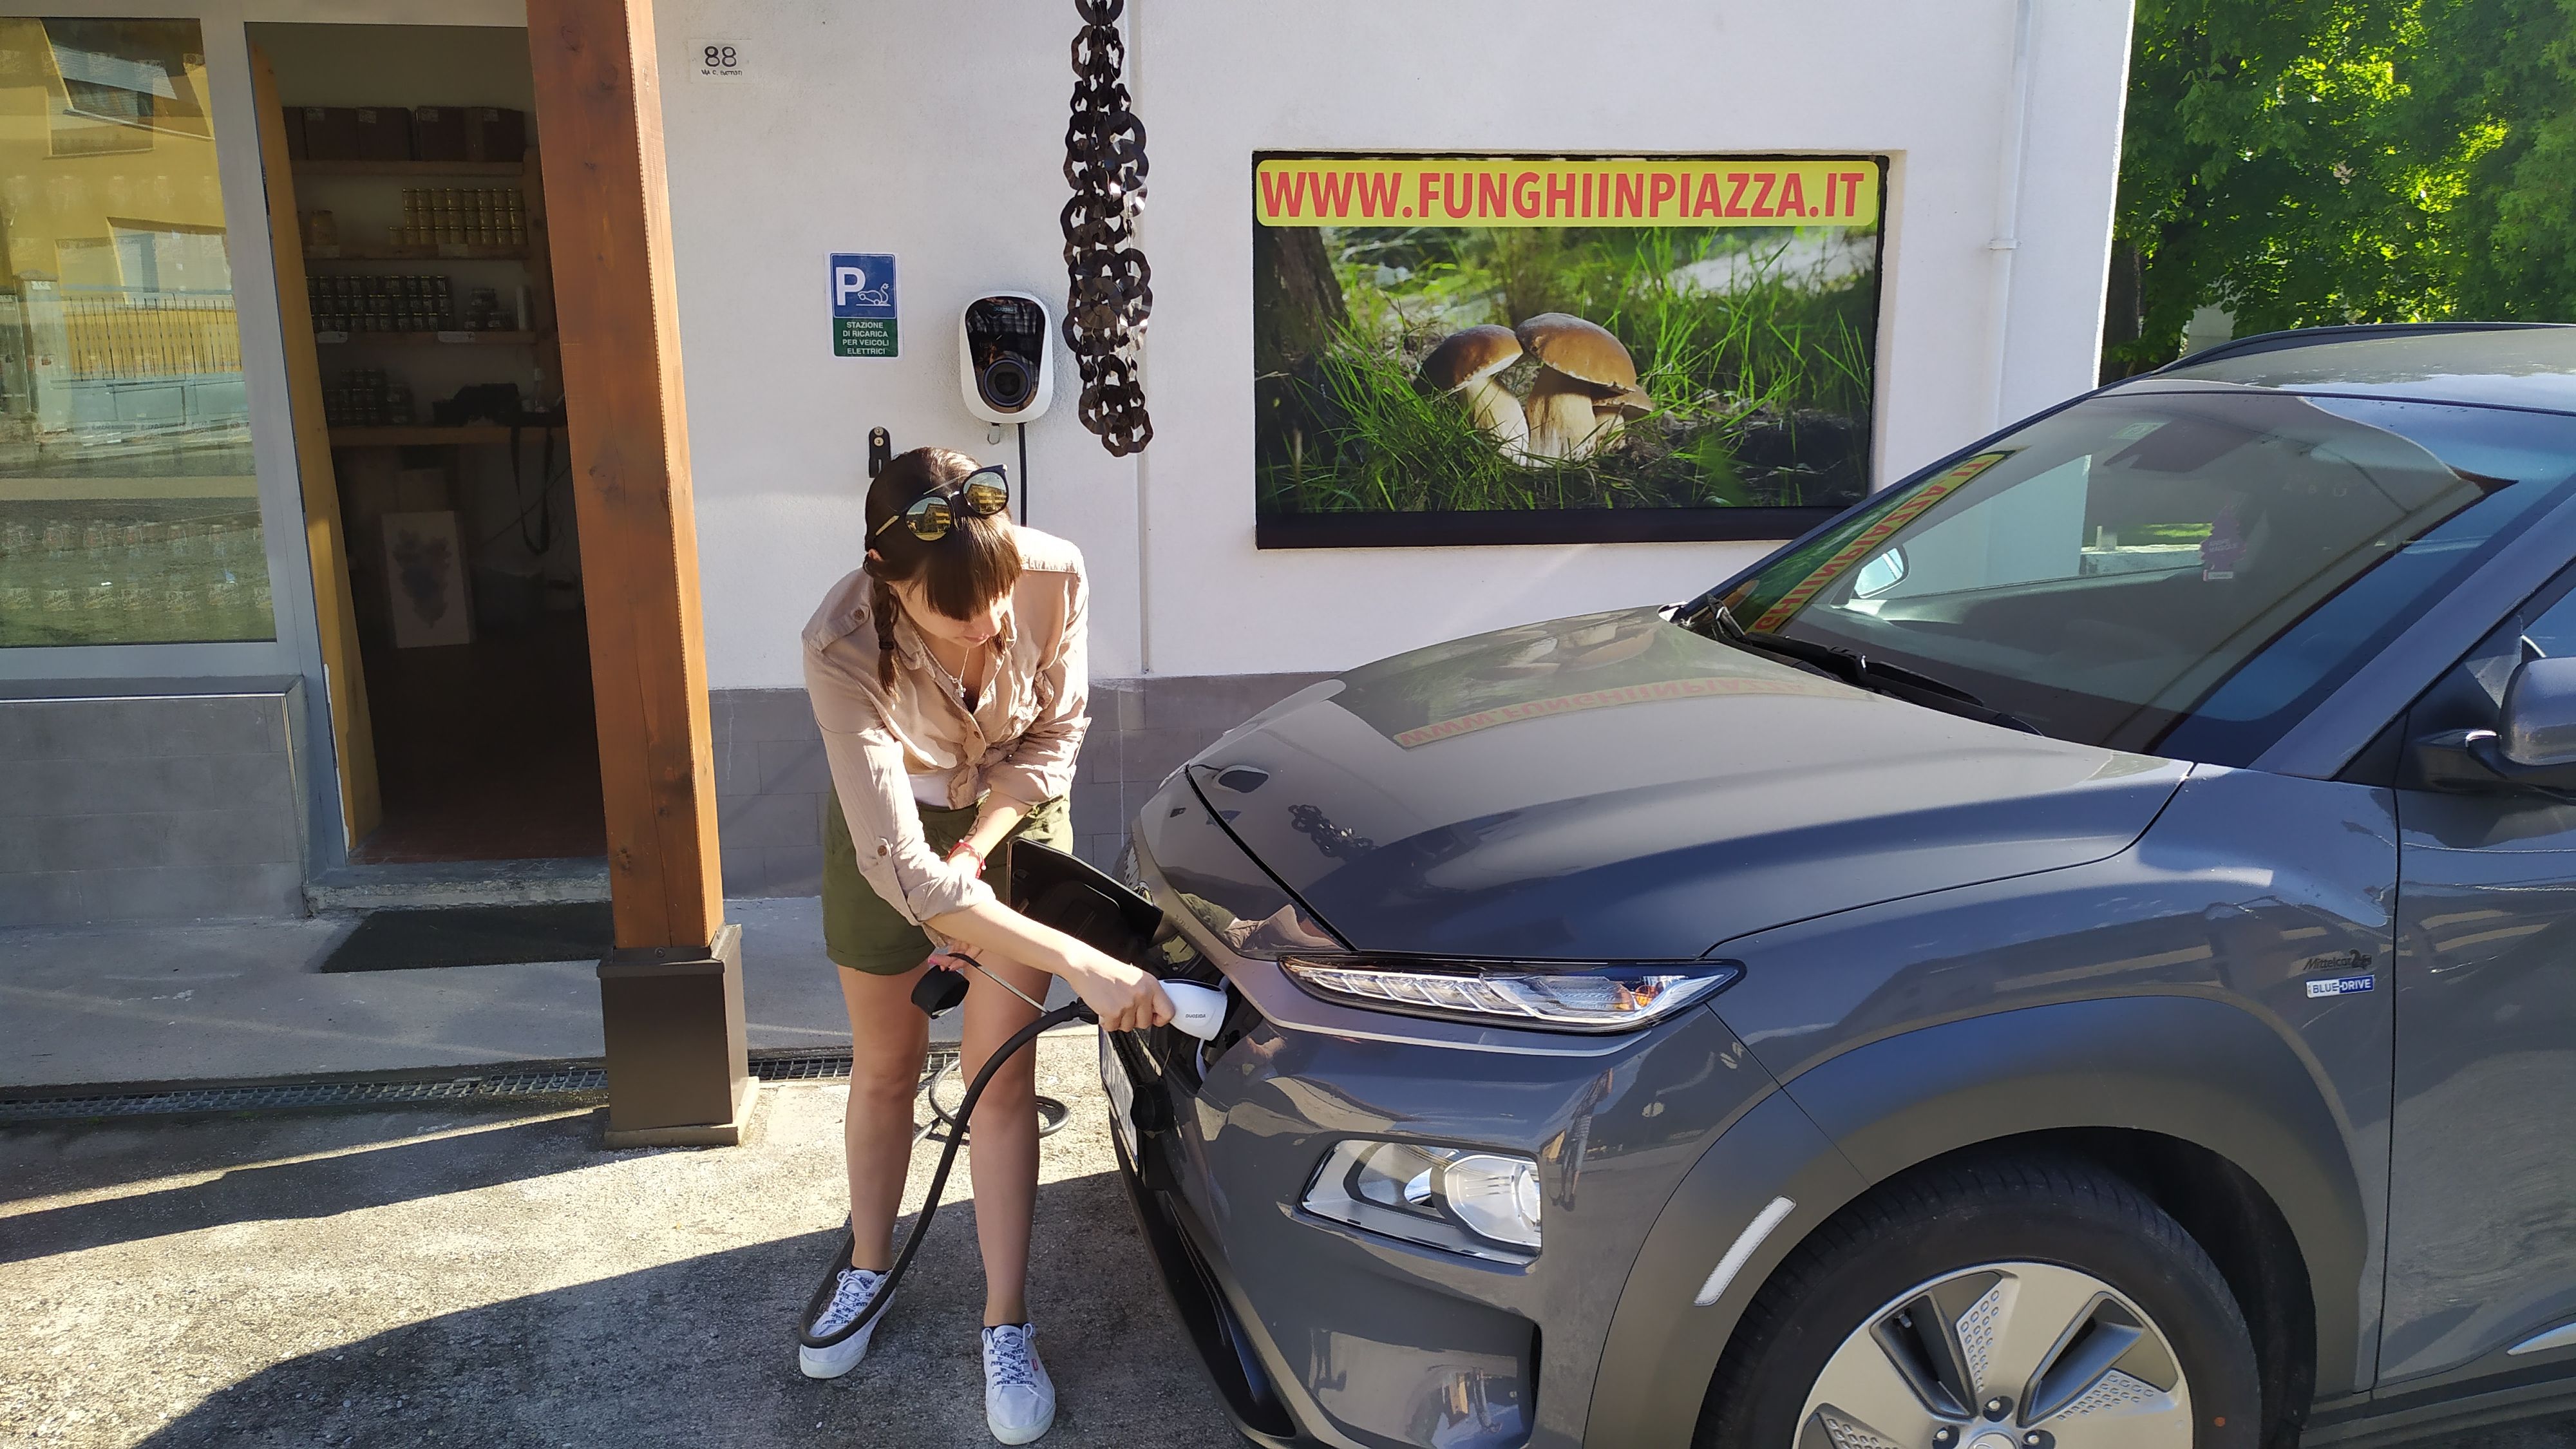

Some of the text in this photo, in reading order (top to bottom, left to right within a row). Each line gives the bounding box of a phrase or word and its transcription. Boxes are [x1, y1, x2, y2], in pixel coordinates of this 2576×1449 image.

[704, 46, 737, 67] 88
[1260, 171, 1865, 220] WWW.FUNGHIINPIAZZA.IT
[836, 267, 866, 306] P
[2313, 978, 2372, 994] BLUE-DRIVE
